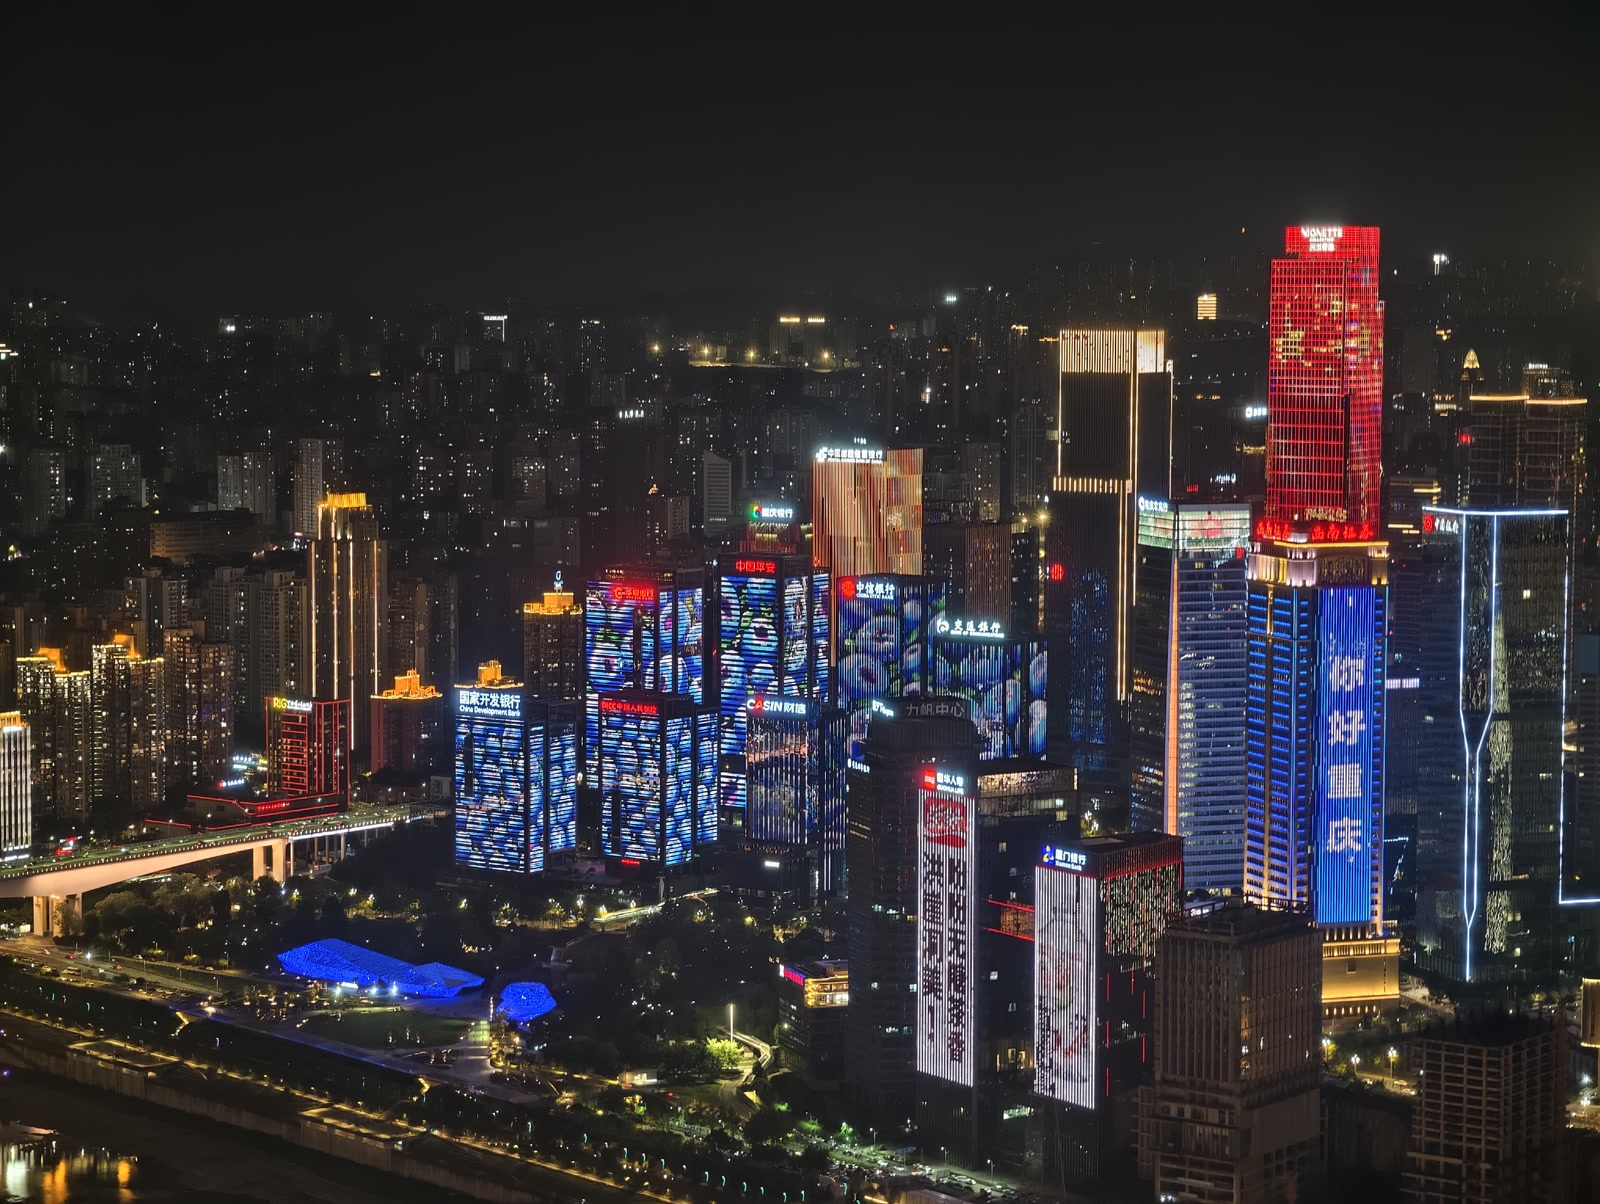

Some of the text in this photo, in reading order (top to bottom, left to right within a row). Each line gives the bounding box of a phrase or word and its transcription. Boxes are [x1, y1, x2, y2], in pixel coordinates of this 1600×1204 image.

[1301, 226, 1343, 238] VIGNETTE
[827, 448, 883, 459] 中国邮政储蓄银行
[762, 507, 794, 519] 重庆银行
[1311, 521, 1375, 541] 西南证券
[735, 560, 776, 573] 中国平安
[856, 581, 895, 596] 中信银行
[460, 690, 521, 709] 国家开发银行
[746, 699, 806, 714] CASIN 财信
[460, 704, 521, 717] China Development Bank
[601, 701, 657, 714] PICC 中国人民保险
[906, 702, 965, 718] 力帆中心
[1328, 656, 1365, 853] 你好重庆
[937, 772, 964, 787] 国华人寿
[937, 784, 965, 795] GUOHUA LIFE
[1055, 849, 1087, 866] 厦门银行
